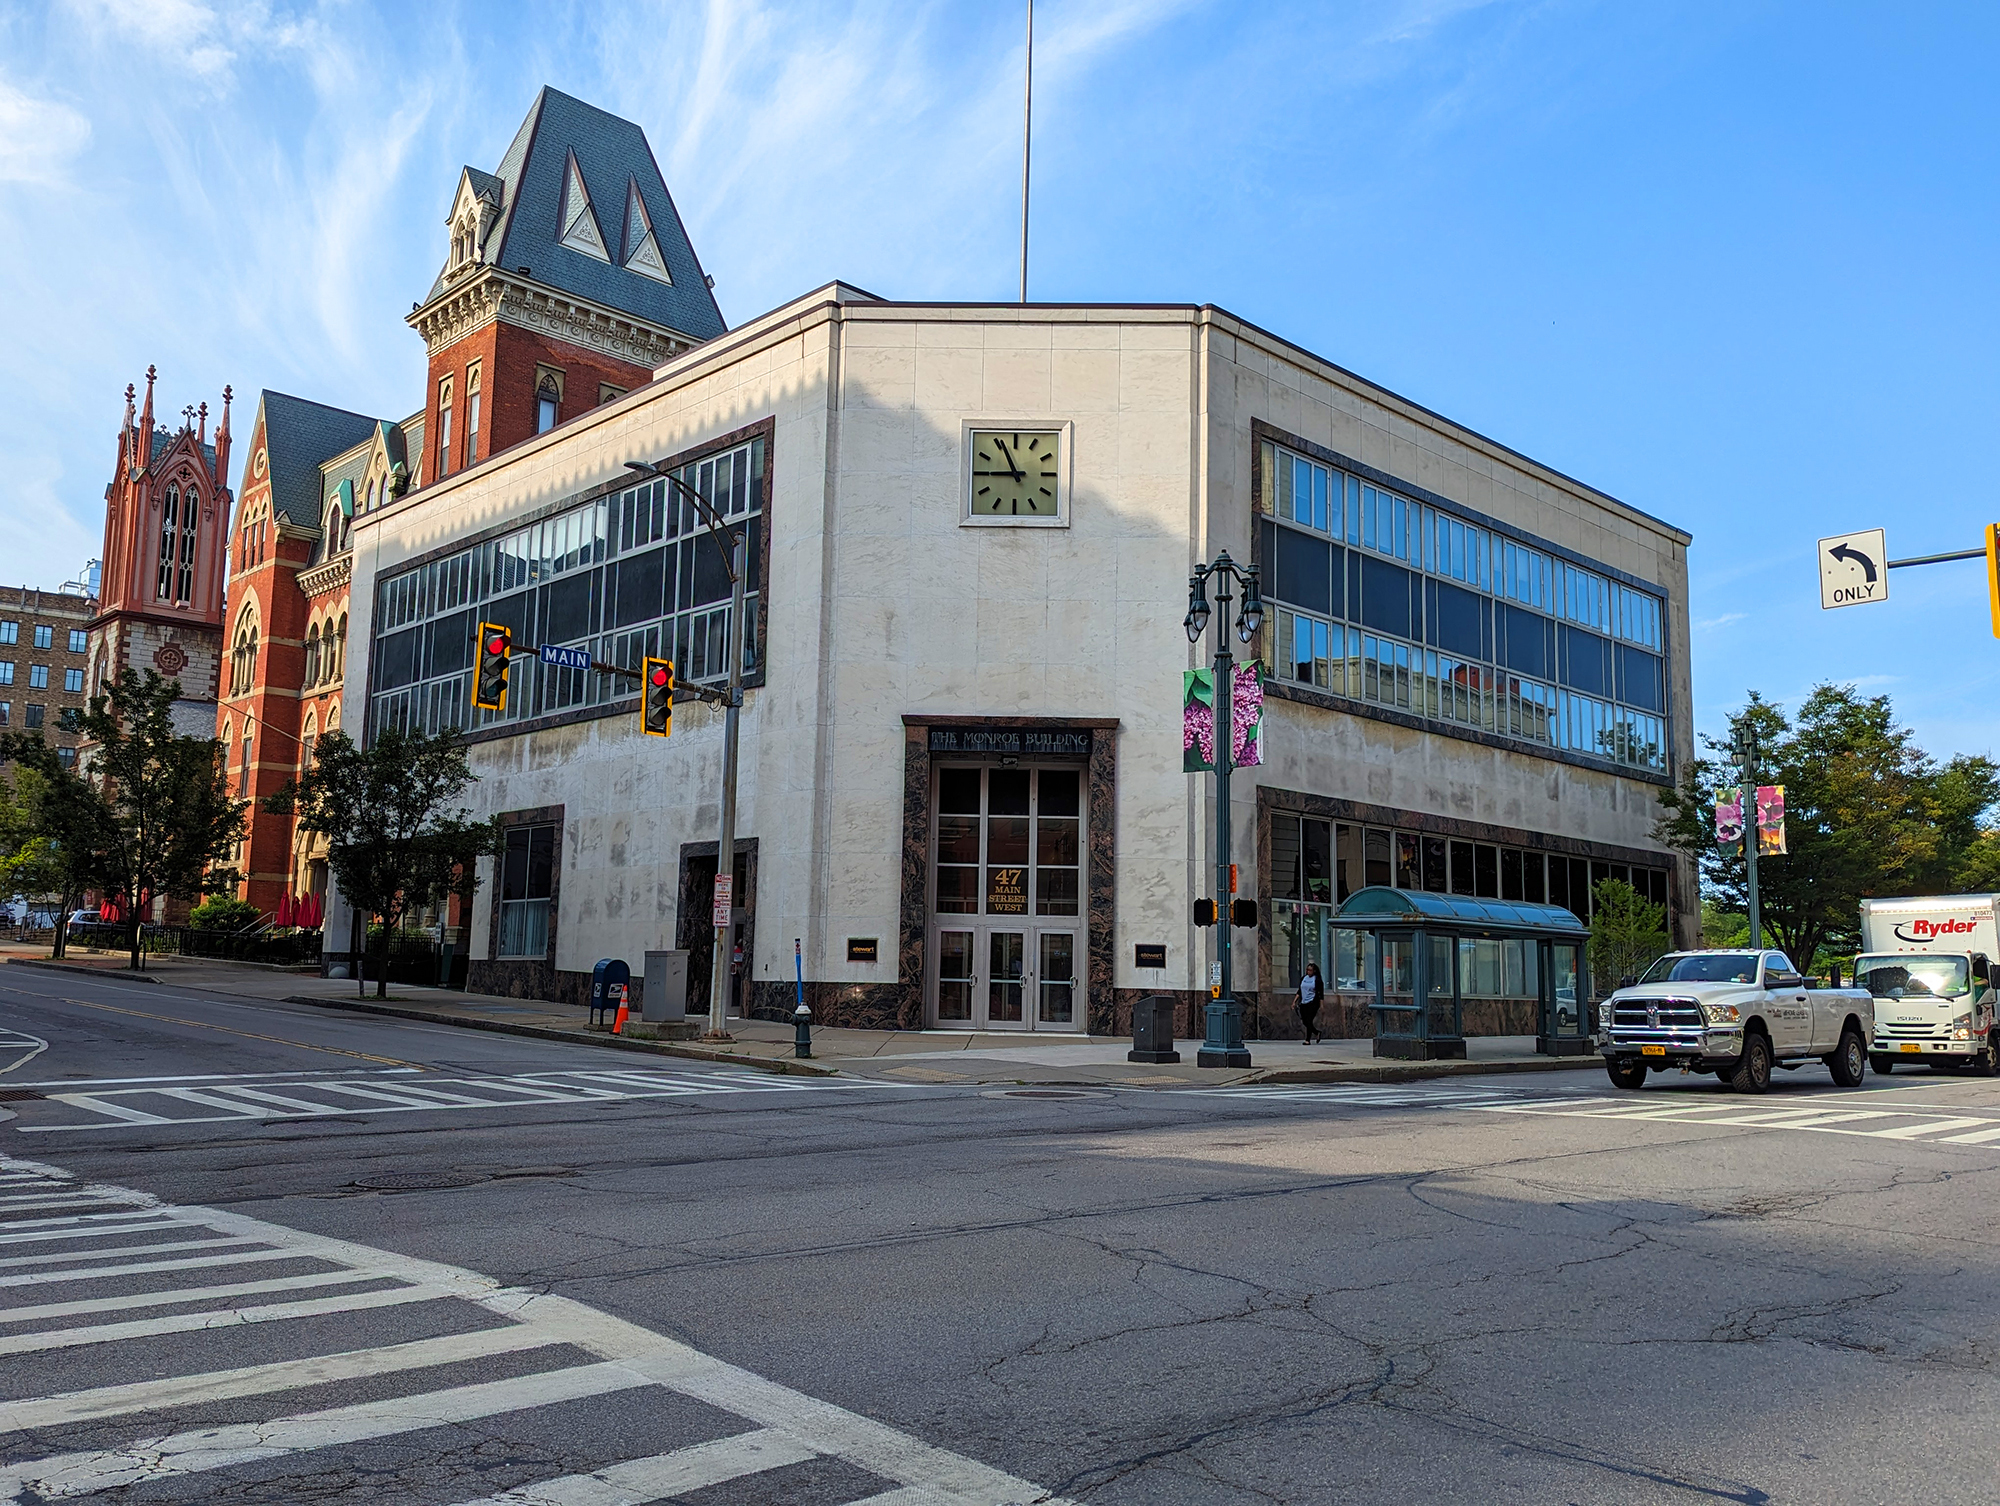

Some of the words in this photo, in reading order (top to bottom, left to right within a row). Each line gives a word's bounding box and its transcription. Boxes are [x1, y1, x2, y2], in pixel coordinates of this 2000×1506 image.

[1833, 583, 1876, 603] ONLY
[545, 647, 586, 667] MAIN
[931, 732, 958, 743] THE
[963, 732, 1020, 745] MONROE
[1025, 733, 1089, 746] BUILDING
[994, 869, 1022, 885] 47
[994, 885, 1022, 894] MAIN
[988, 894, 1027, 903] STREET
[994, 903, 1023, 912] WEST
[1913, 919, 1977, 937] Ryder
